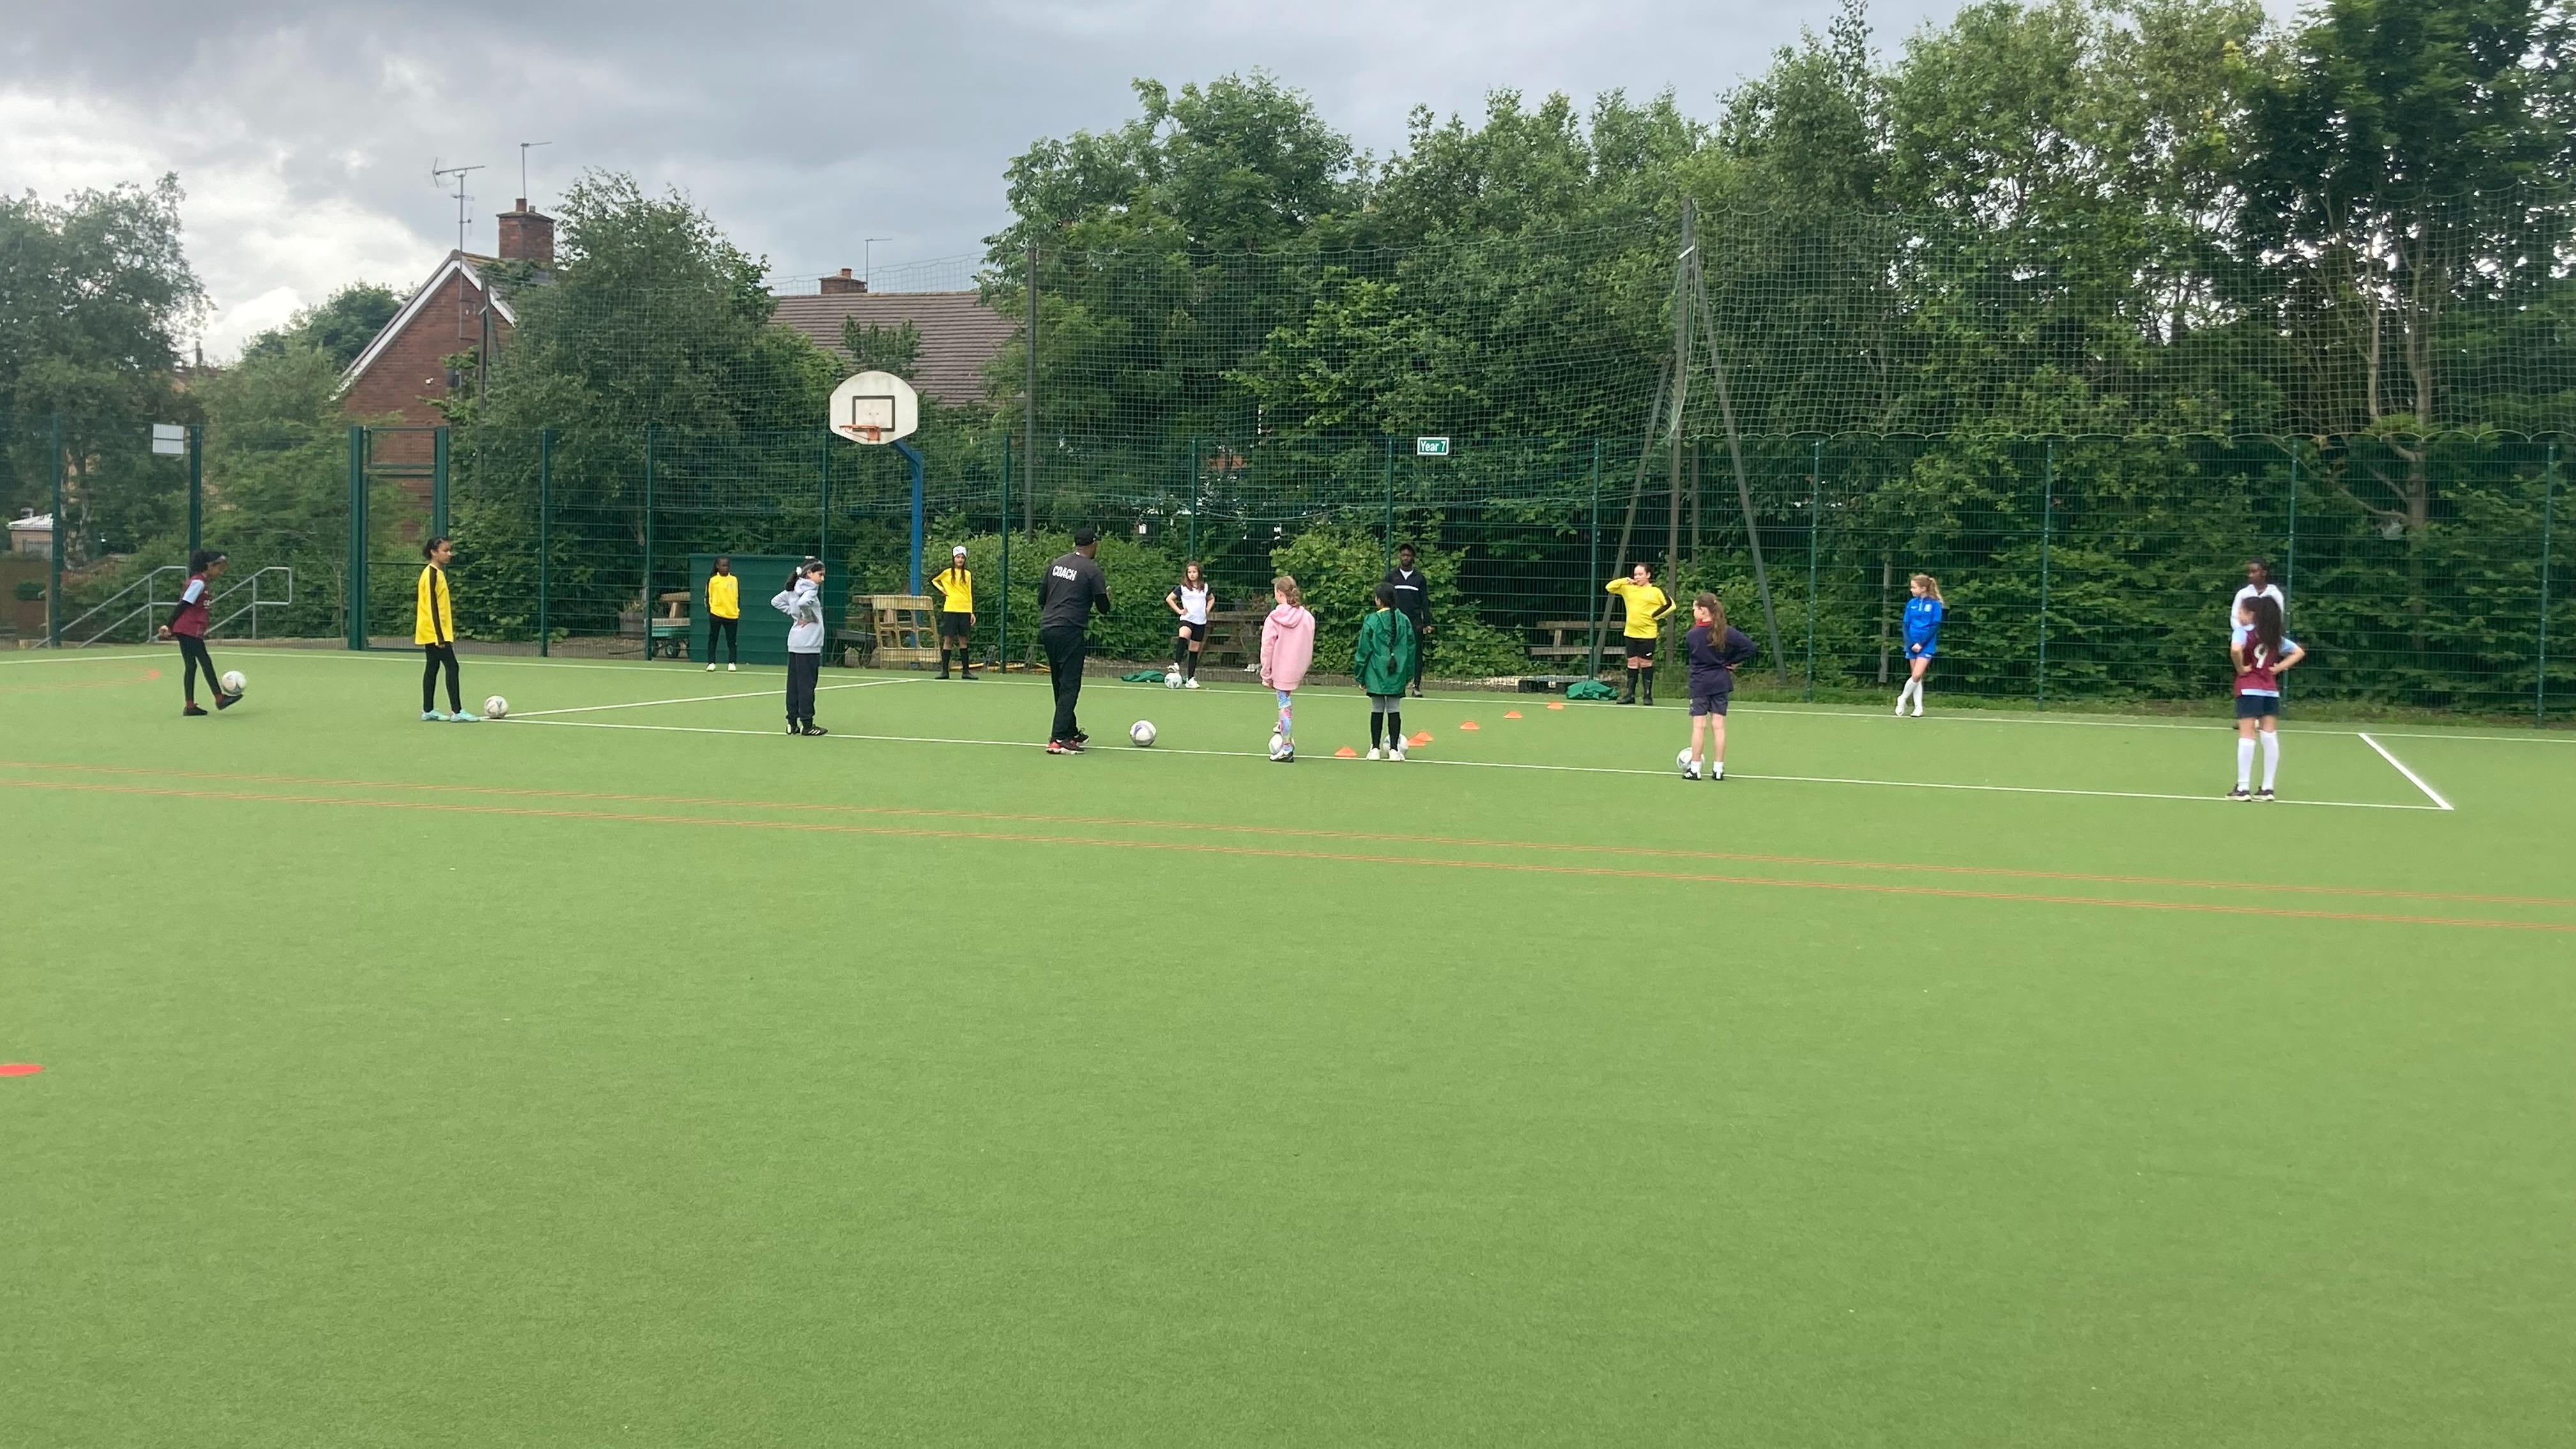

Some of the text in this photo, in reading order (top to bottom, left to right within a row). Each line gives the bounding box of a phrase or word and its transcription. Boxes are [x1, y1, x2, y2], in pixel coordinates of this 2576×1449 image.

[1420, 440, 1446, 452] Year 7
[1052, 565, 1077, 581] COACH
[2253, 643, 2268, 668] 9
